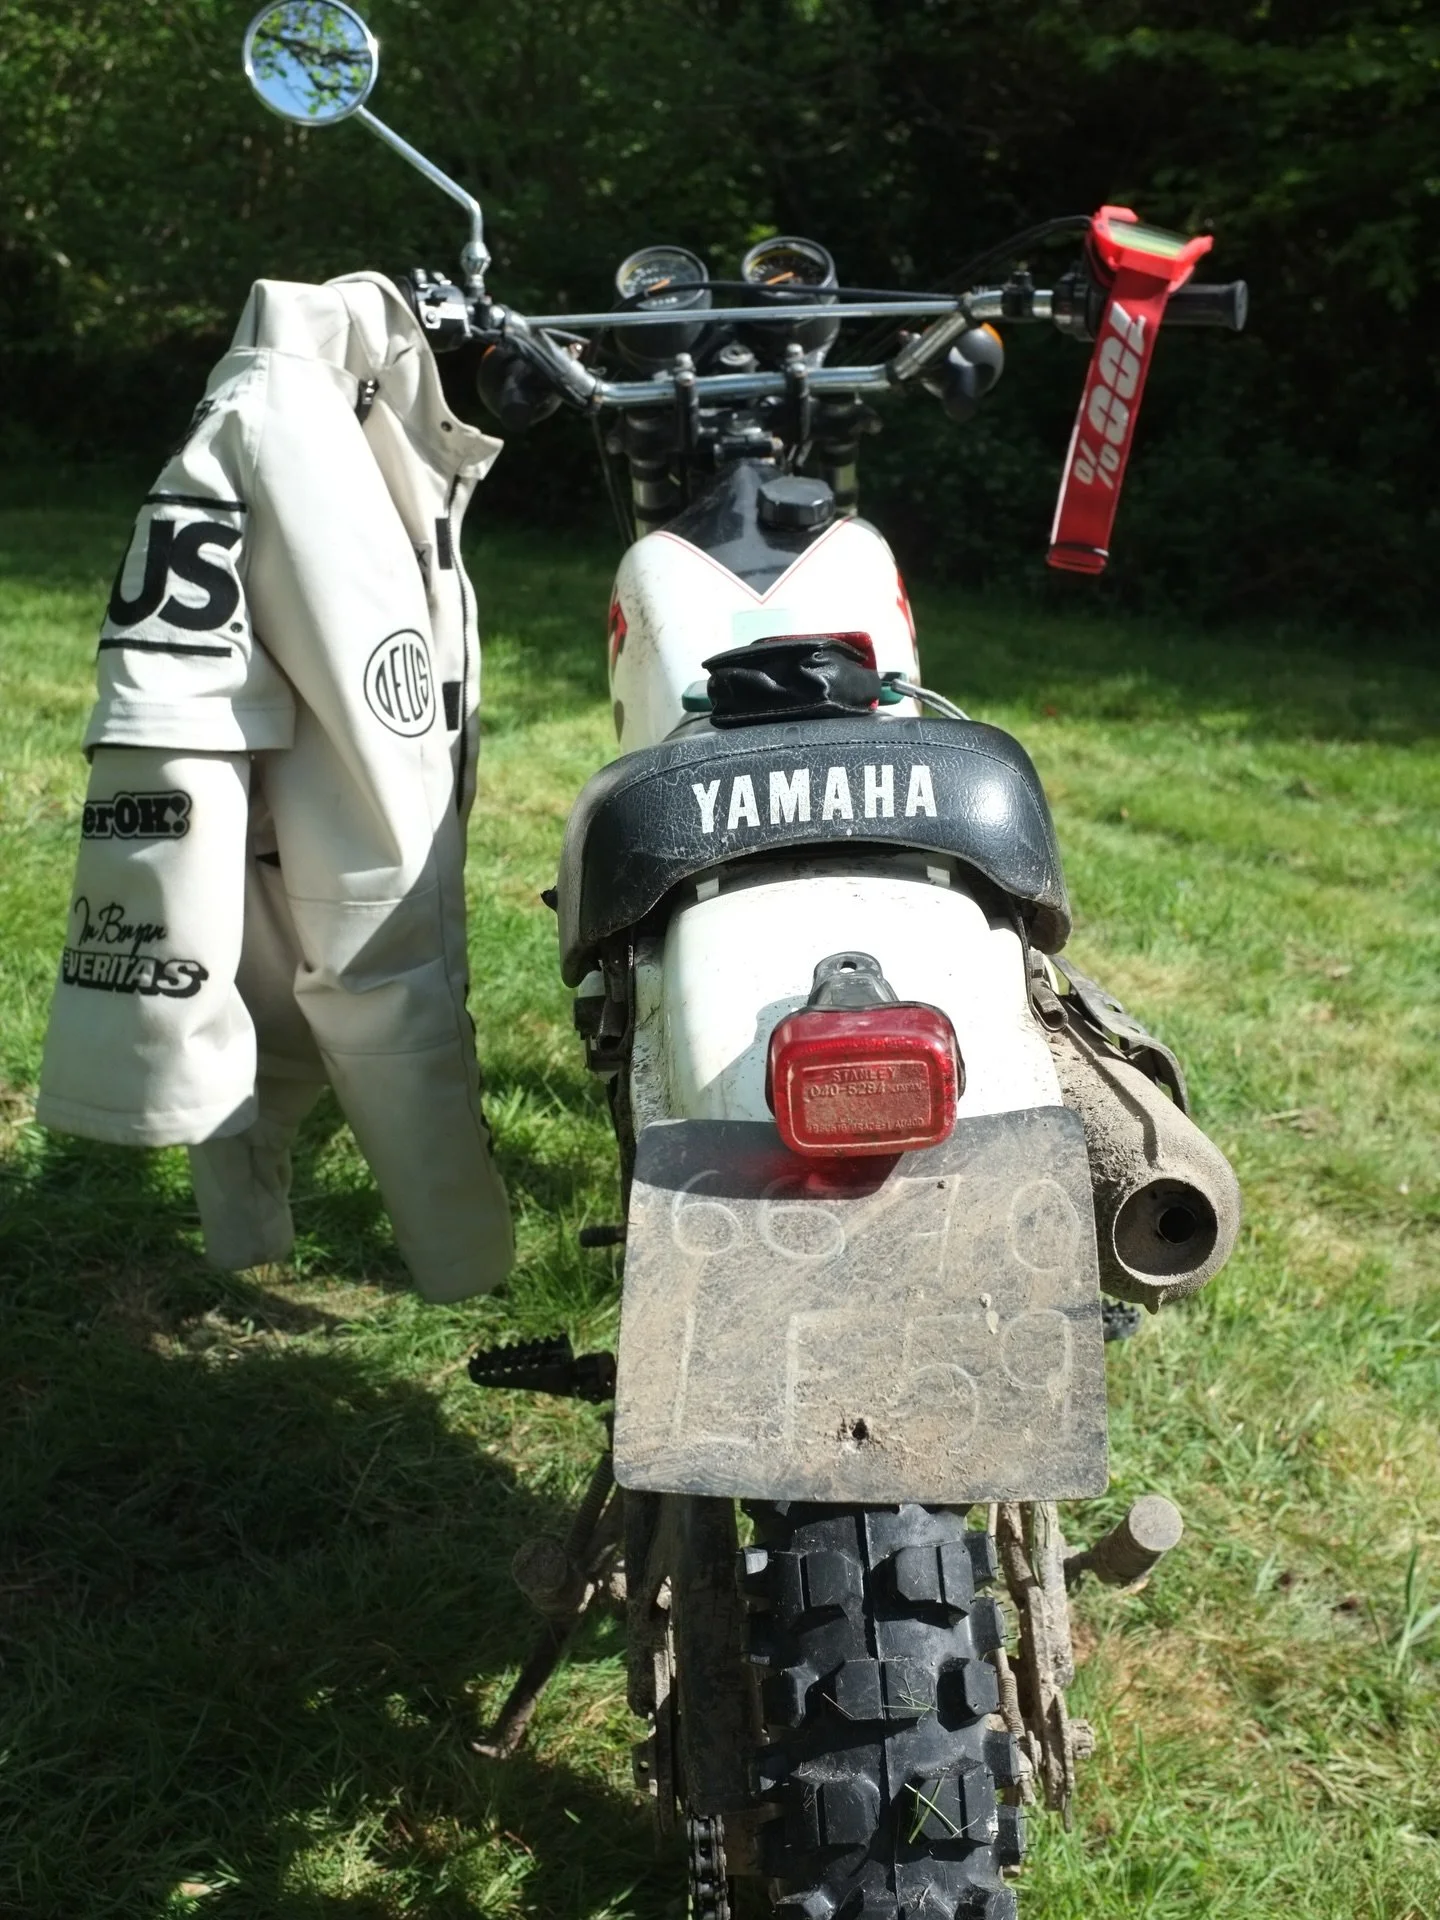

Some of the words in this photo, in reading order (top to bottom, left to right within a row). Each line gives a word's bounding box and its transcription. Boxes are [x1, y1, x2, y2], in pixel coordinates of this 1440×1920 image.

[375, 643, 430, 724] DEUS
[691, 764, 938, 834] YAMAHA
[832, 1065, 897, 1082] STANLEY
